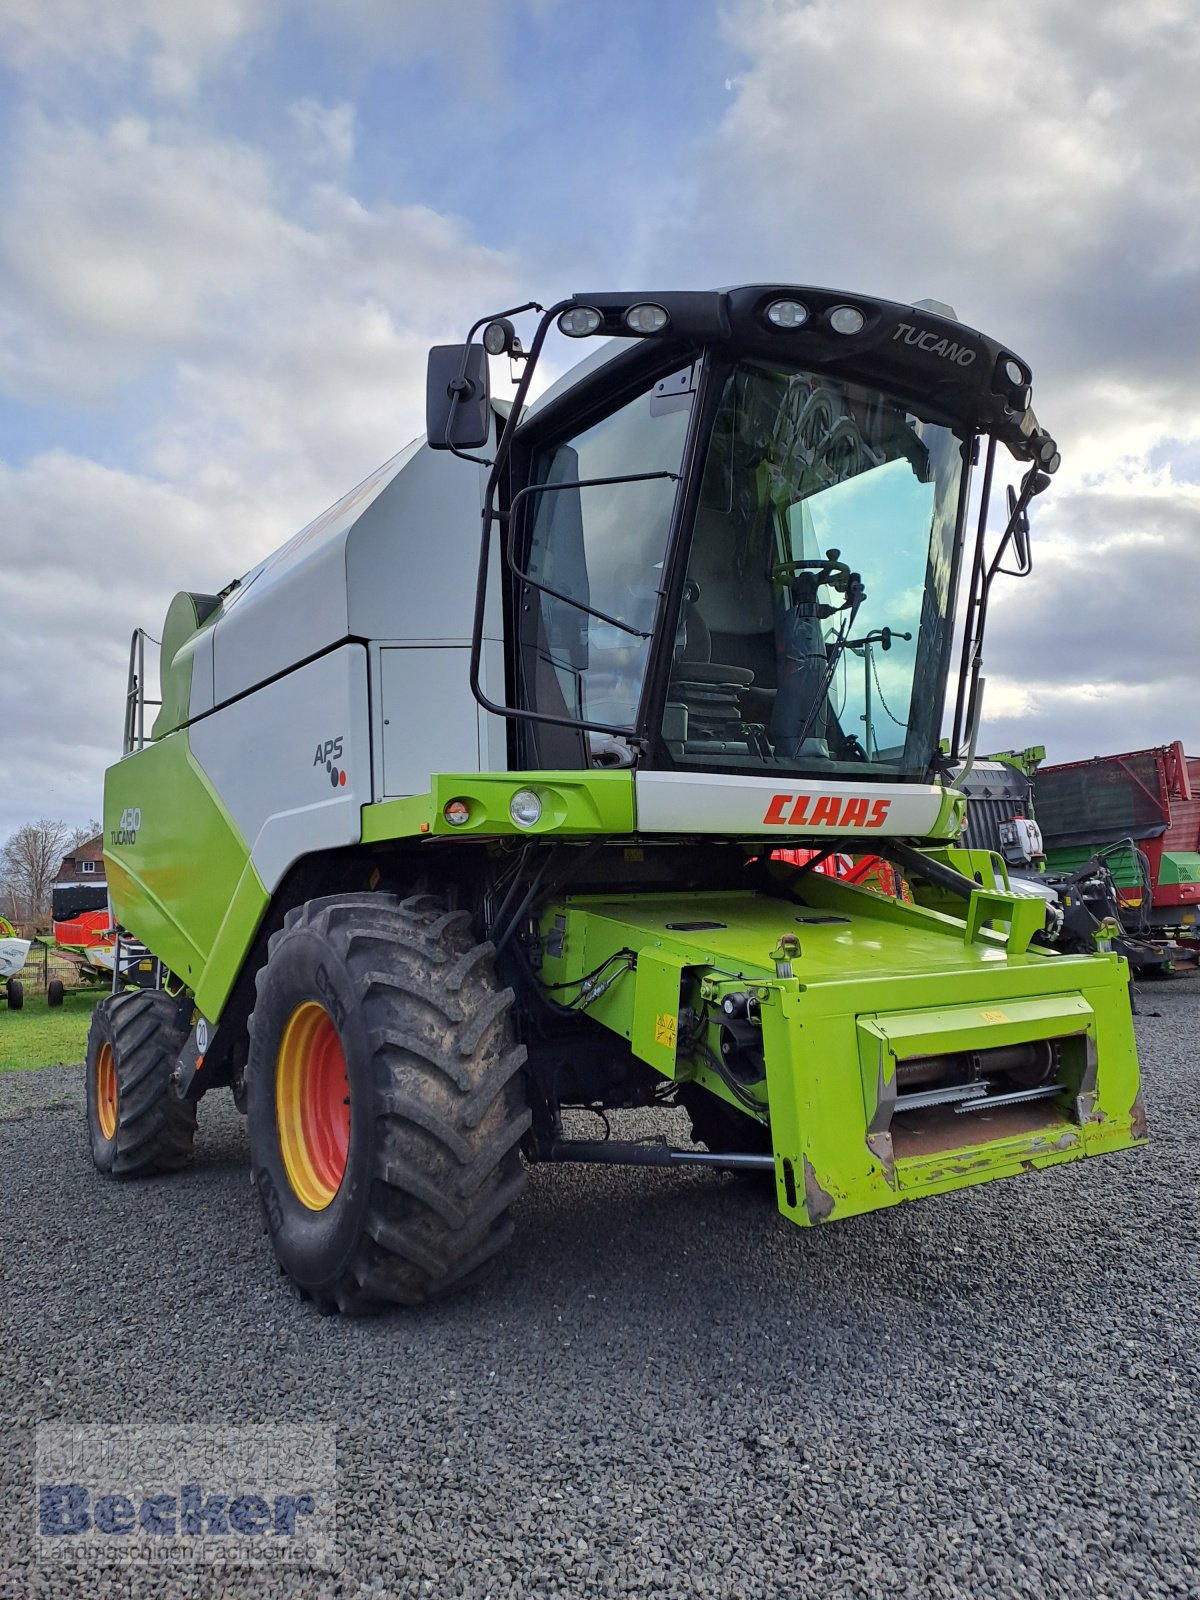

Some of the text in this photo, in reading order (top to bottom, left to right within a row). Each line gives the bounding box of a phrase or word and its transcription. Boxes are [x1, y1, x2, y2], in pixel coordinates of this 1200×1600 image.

[892, 323, 976, 367] TUCANO
[313, 736, 344, 767] APS
[763, 794, 891, 828] CLAAS
[111, 830, 136, 846] TUCANO
[198, 1023, 206, 1046] 20
